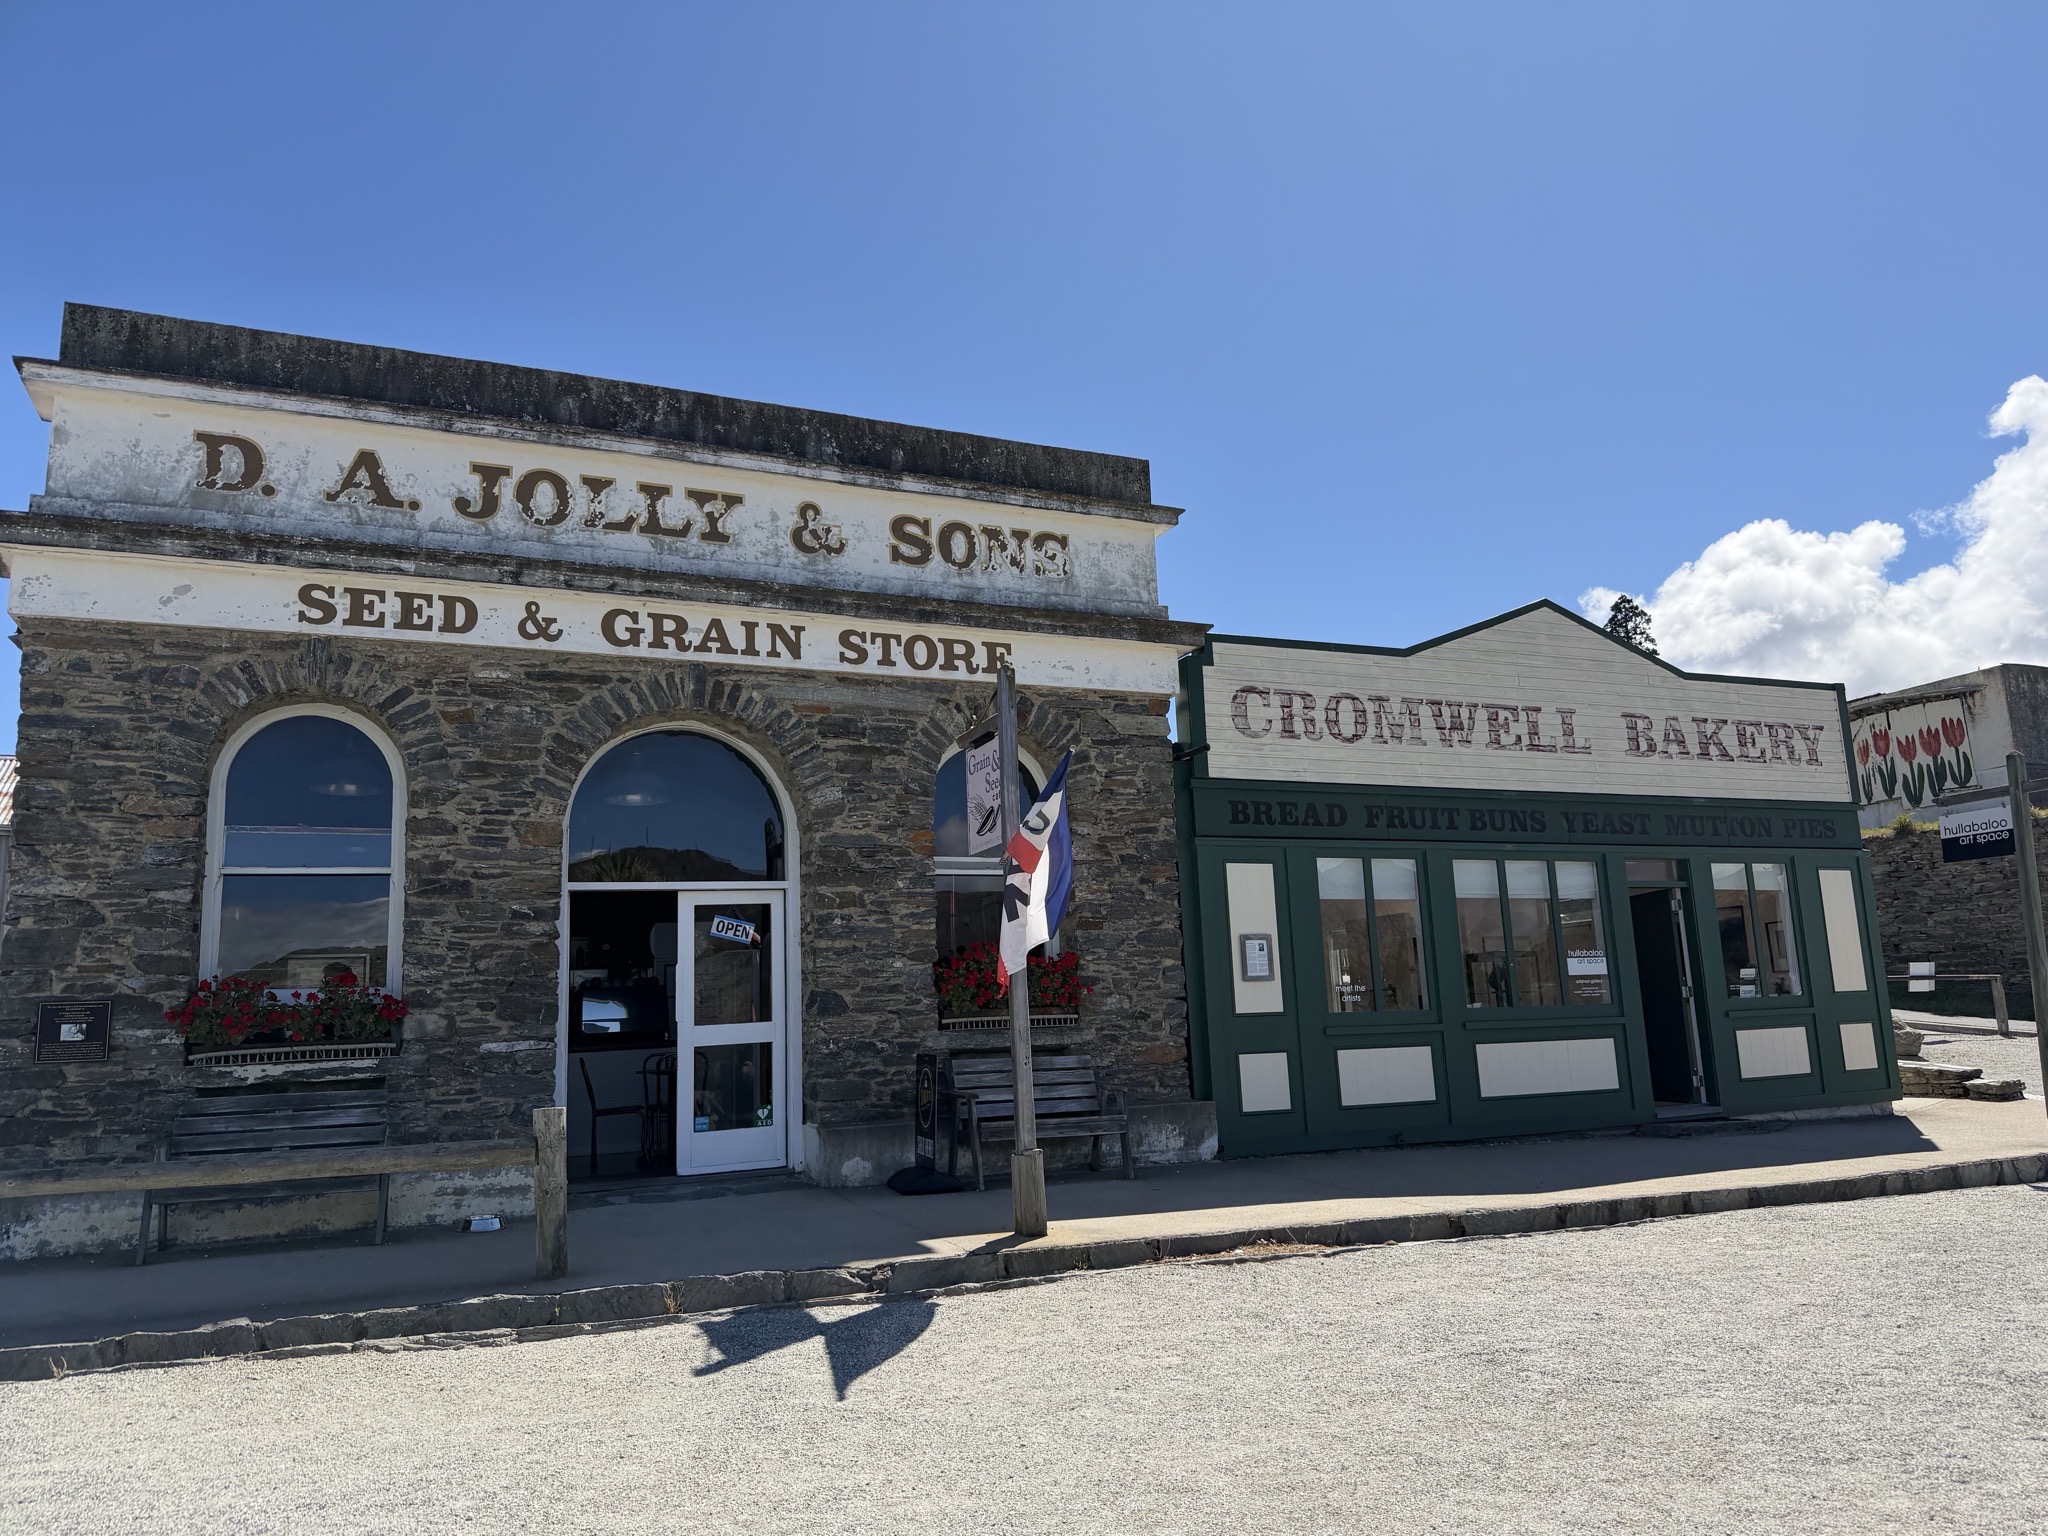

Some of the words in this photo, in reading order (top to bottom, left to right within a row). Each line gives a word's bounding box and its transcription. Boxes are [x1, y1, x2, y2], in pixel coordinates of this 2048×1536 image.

[194, 430, 279, 499] D.
[323, 449, 422, 513] A.
[452, 461, 744, 545] JOLLY
[789, 500, 848, 558] &
[889, 514, 1073, 580] SONS
[298, 583, 478, 634] SEED
[517, 600, 564, 642] &
[601, 608, 805, 660] GRAIN
[838, 629, 1012, 675] STORE
[1230, 685, 1592, 755] CROMWELL
[1621, 712, 1824, 767] BAKERY
[968, 754, 991, 775] Grain
[991, 749, 1000, 772] &
[985, 772, 1000, 793] See
[1229, 801, 1347, 827] BREAD
[1364, 804, 1460, 831] FRUIT
[1467, 808, 1547, 833] BUNS
[1560, 811, 1650, 835] YEAST
[1664, 814, 1773, 838] MUTTON
[1782, 818, 1837, 839] PIES
[1943, 819, 2008, 836] hullabaloo
[1959, 835, 1974, 845] art
[1976, 831, 2009, 844] space
[716, 920, 752, 940] OPEN
[1567, 949, 1604, 957] hullabaloo
[1341, 994, 1362, 1002] artists
